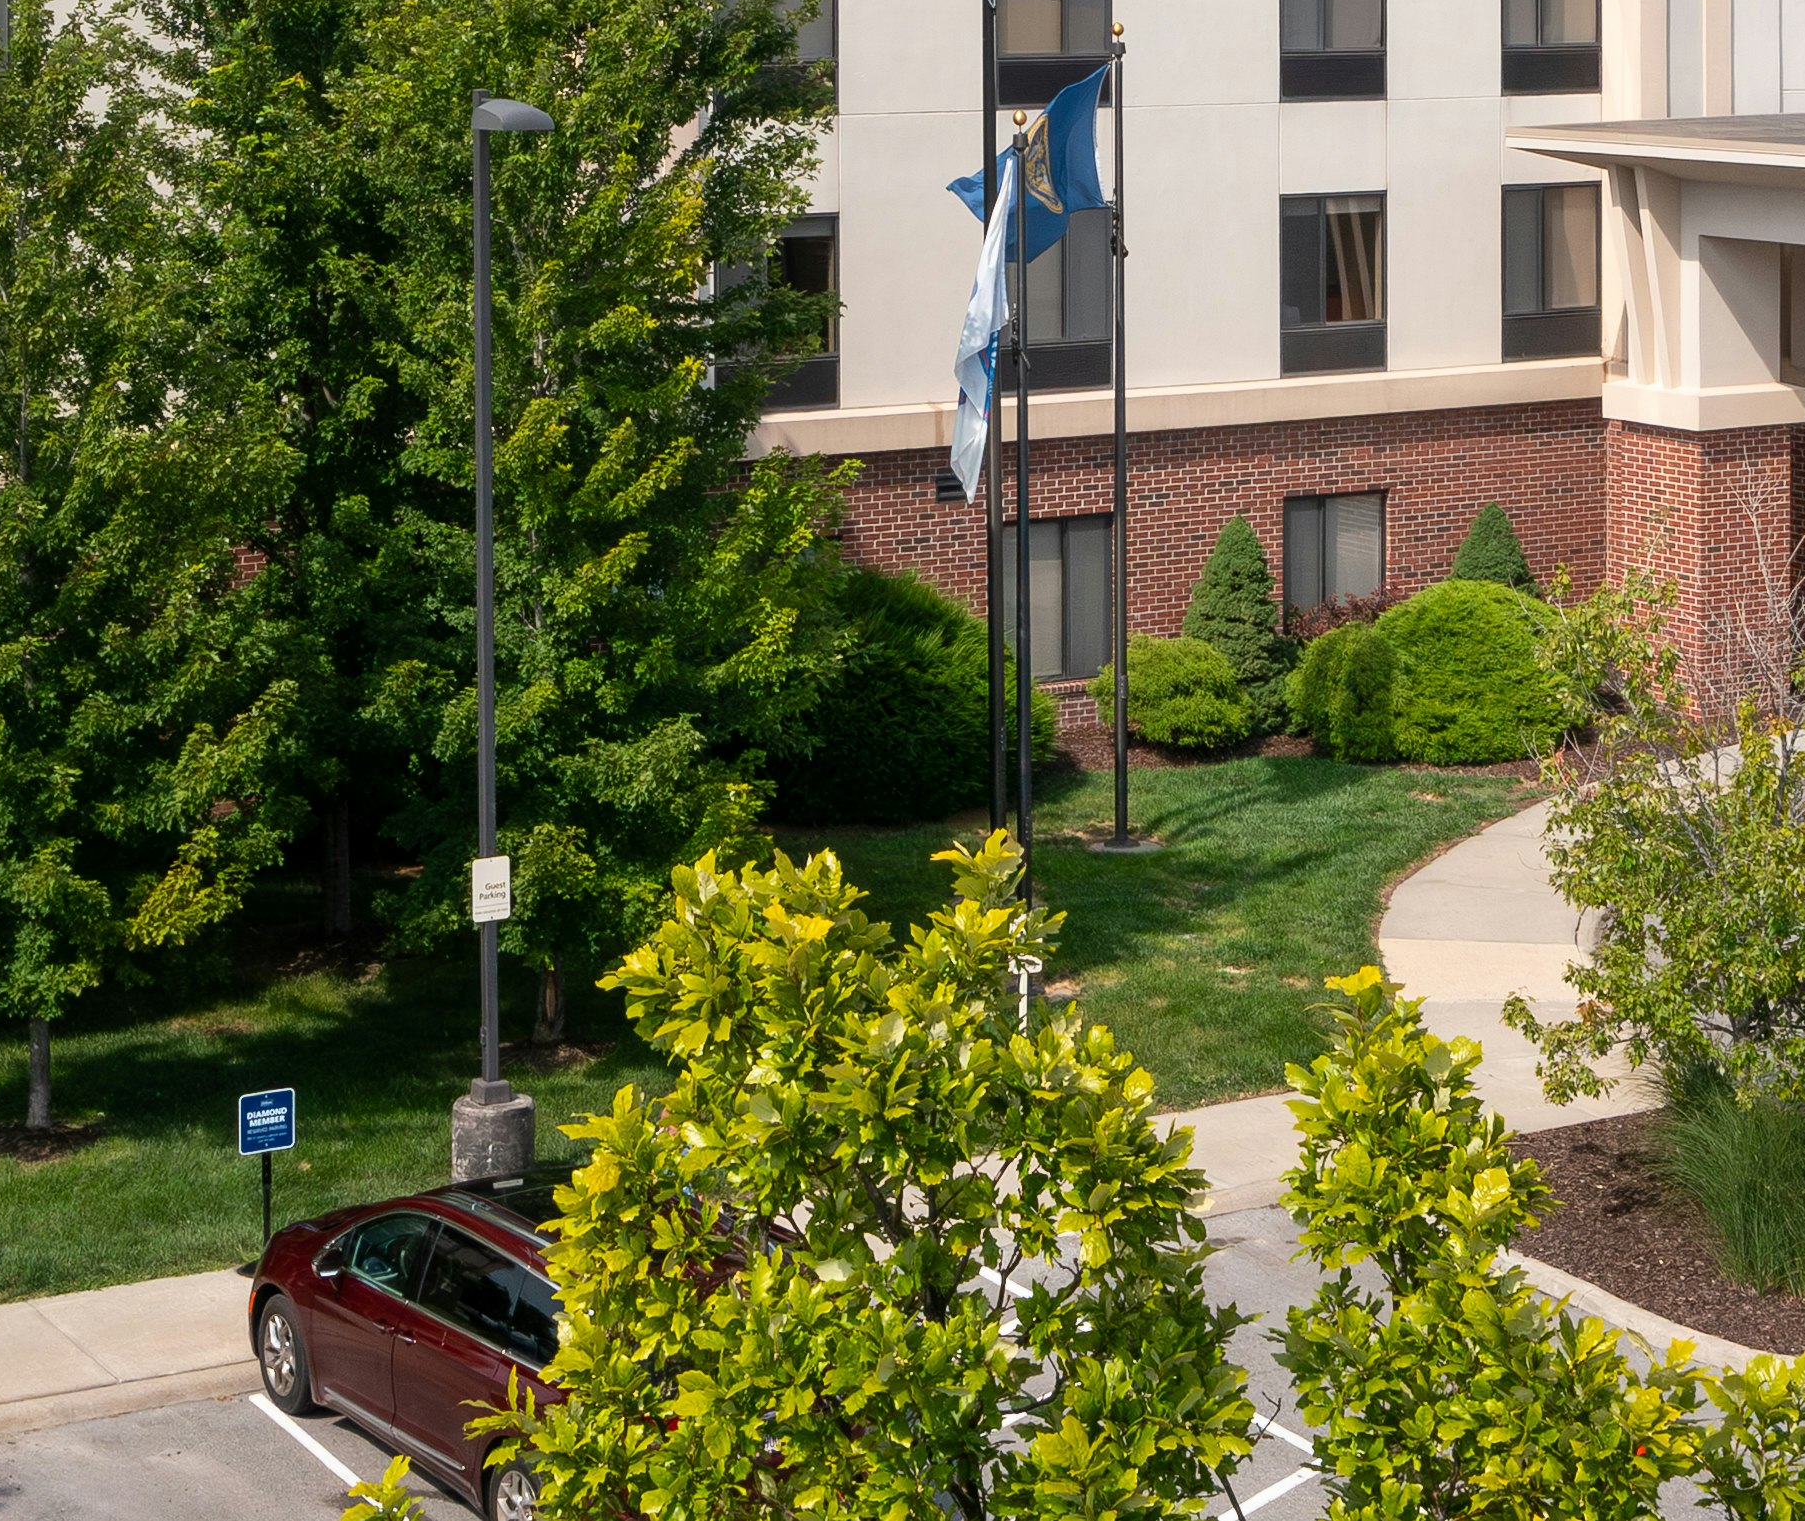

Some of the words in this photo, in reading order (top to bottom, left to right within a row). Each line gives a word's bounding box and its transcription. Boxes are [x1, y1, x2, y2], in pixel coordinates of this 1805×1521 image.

[485, 881, 506, 891] Guest
[479, 890, 506, 900] Parking
[247, 1107, 288, 1120] DIAMOND
[249, 1115, 286, 1127] MEMBER
